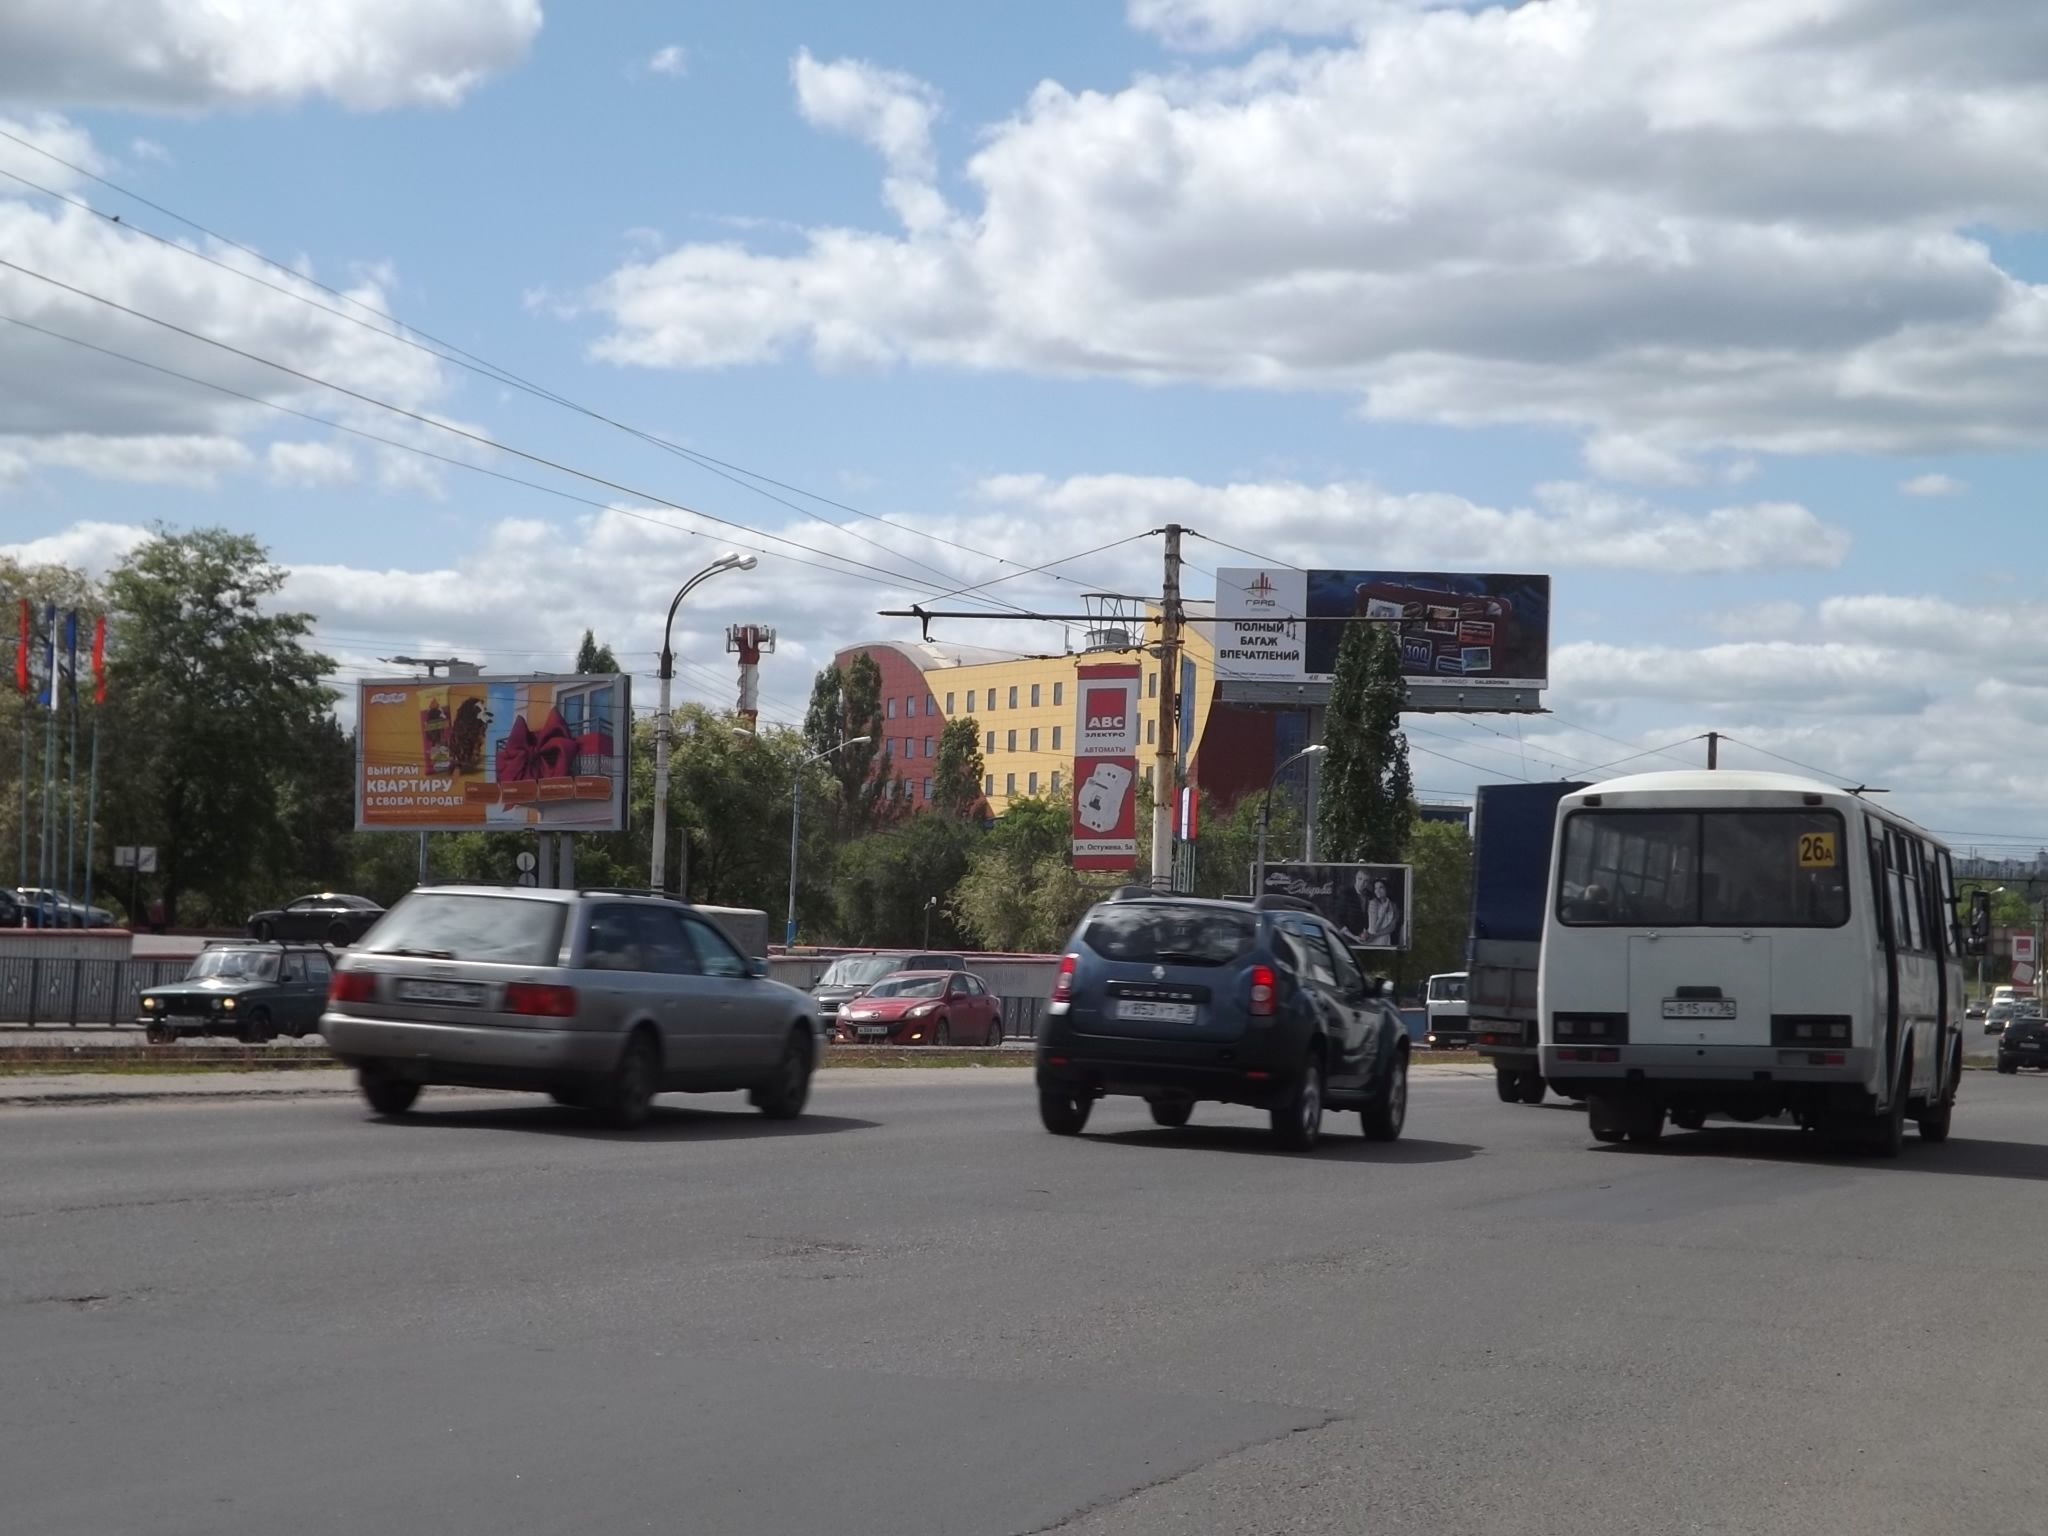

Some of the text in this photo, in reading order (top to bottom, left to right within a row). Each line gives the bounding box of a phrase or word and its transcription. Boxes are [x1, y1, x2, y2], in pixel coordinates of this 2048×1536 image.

[1234, 619, 1284, 633] ПОЛНЫЙ
[1240, 636, 1278, 647] БАГАЖ
[1220, 649, 1300, 661] ВПЕЧАТЛЕНИЙ
[1405, 645, 1428, 659] 300
[1088, 716, 1124, 728] АВС
[367, 763, 419, 776] ВЫИГРАЙ
[367, 779, 453, 793] КВАРТИРУ
[367, 796, 464, 807] В СВОЕМ ГОРОДЕ!
